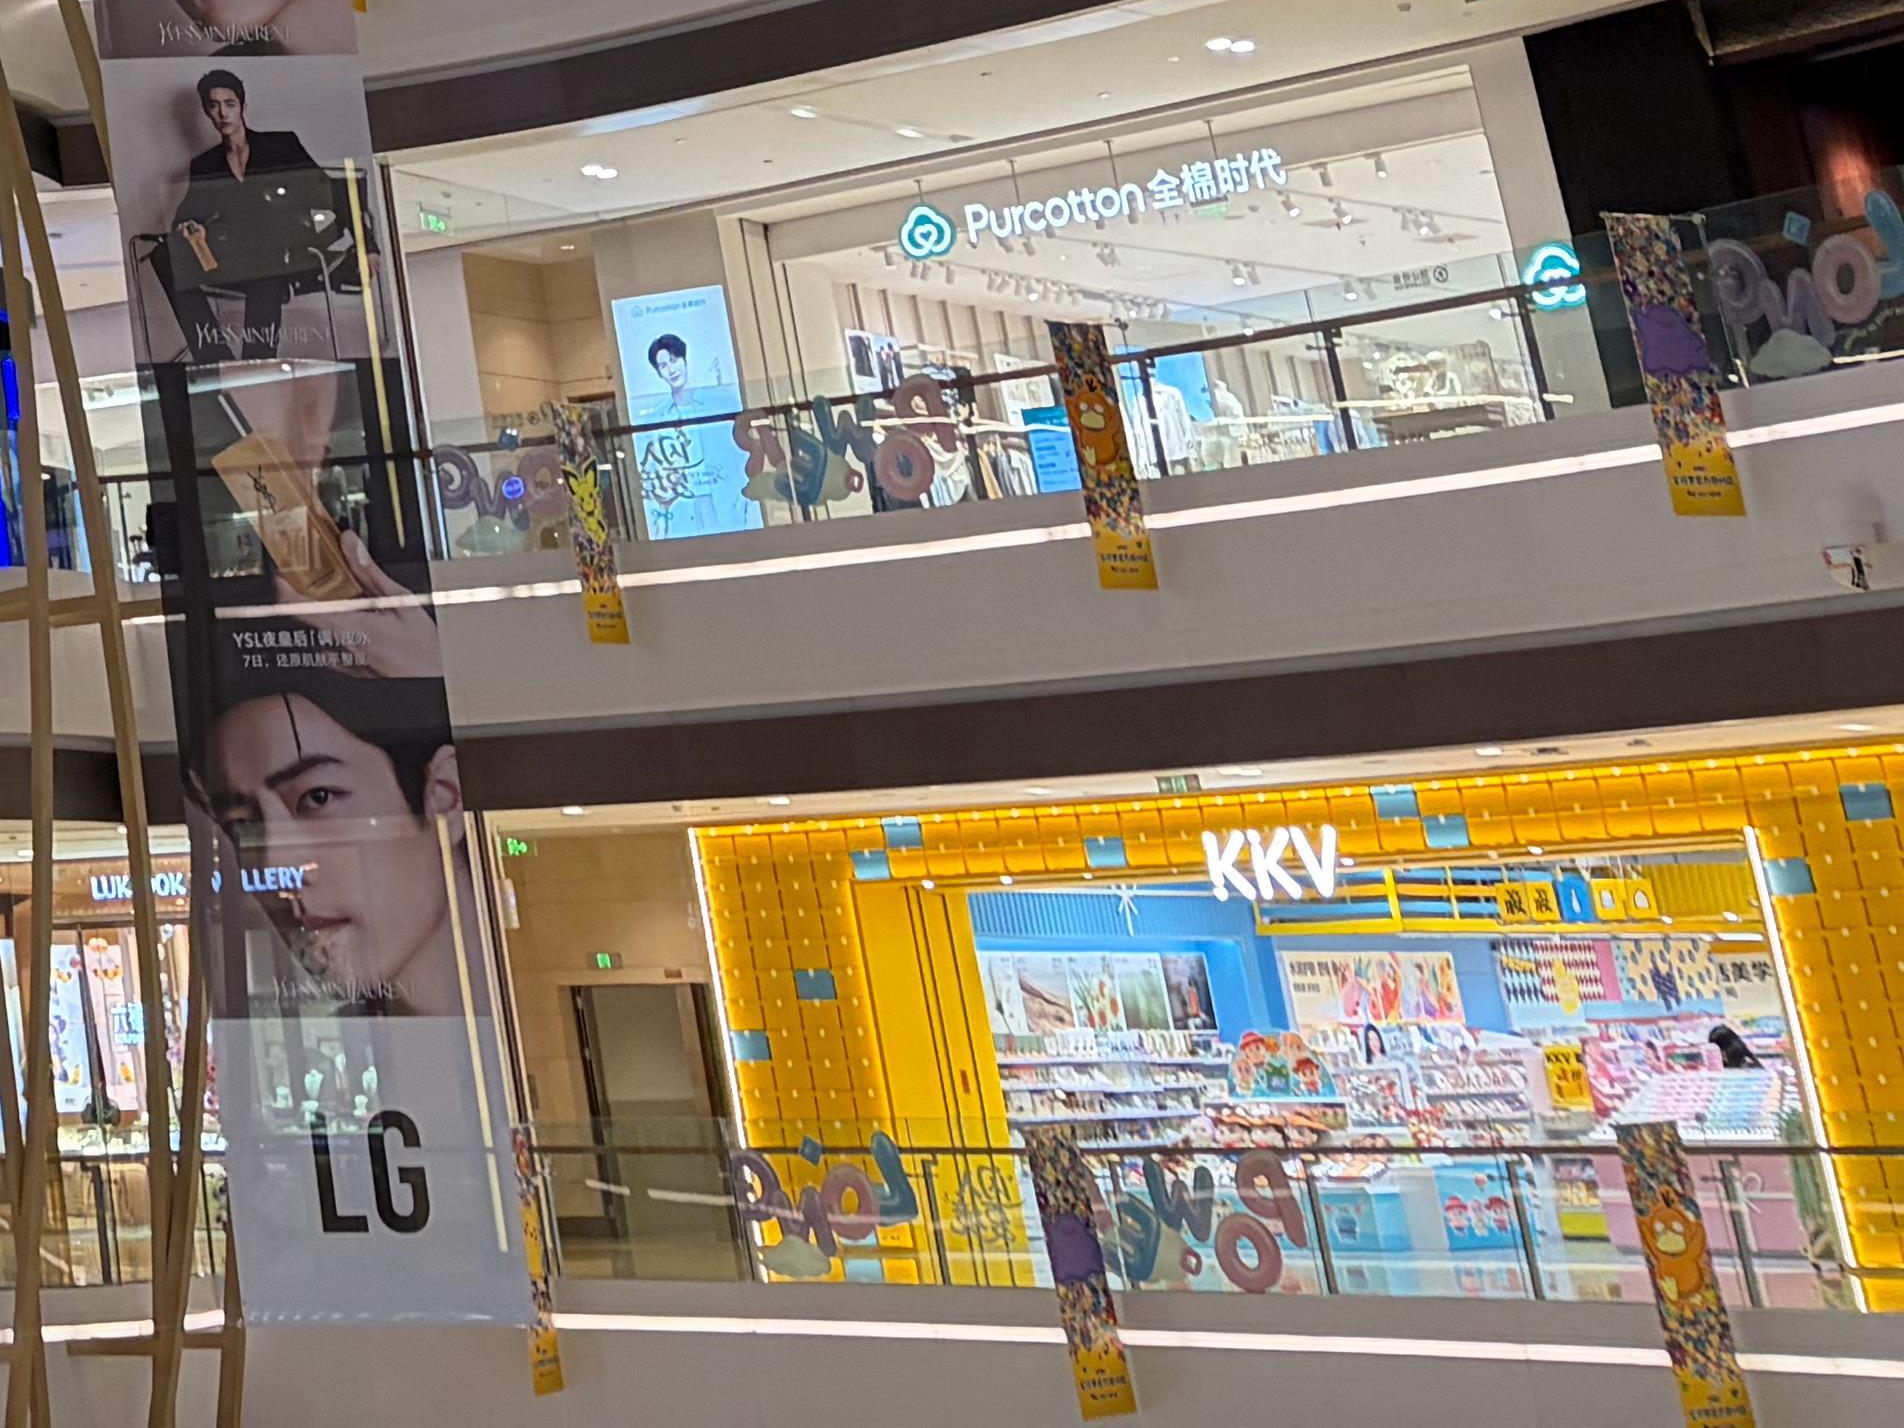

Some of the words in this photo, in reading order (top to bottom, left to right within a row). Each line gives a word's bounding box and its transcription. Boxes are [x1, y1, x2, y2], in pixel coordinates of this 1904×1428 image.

[962, 180, 1146, 245] Purcotton
[1147, 147, 1287, 210] 全棉时代
[1202, 823, 1338, 902] KKV
[310, 1108, 431, 1235] LG
